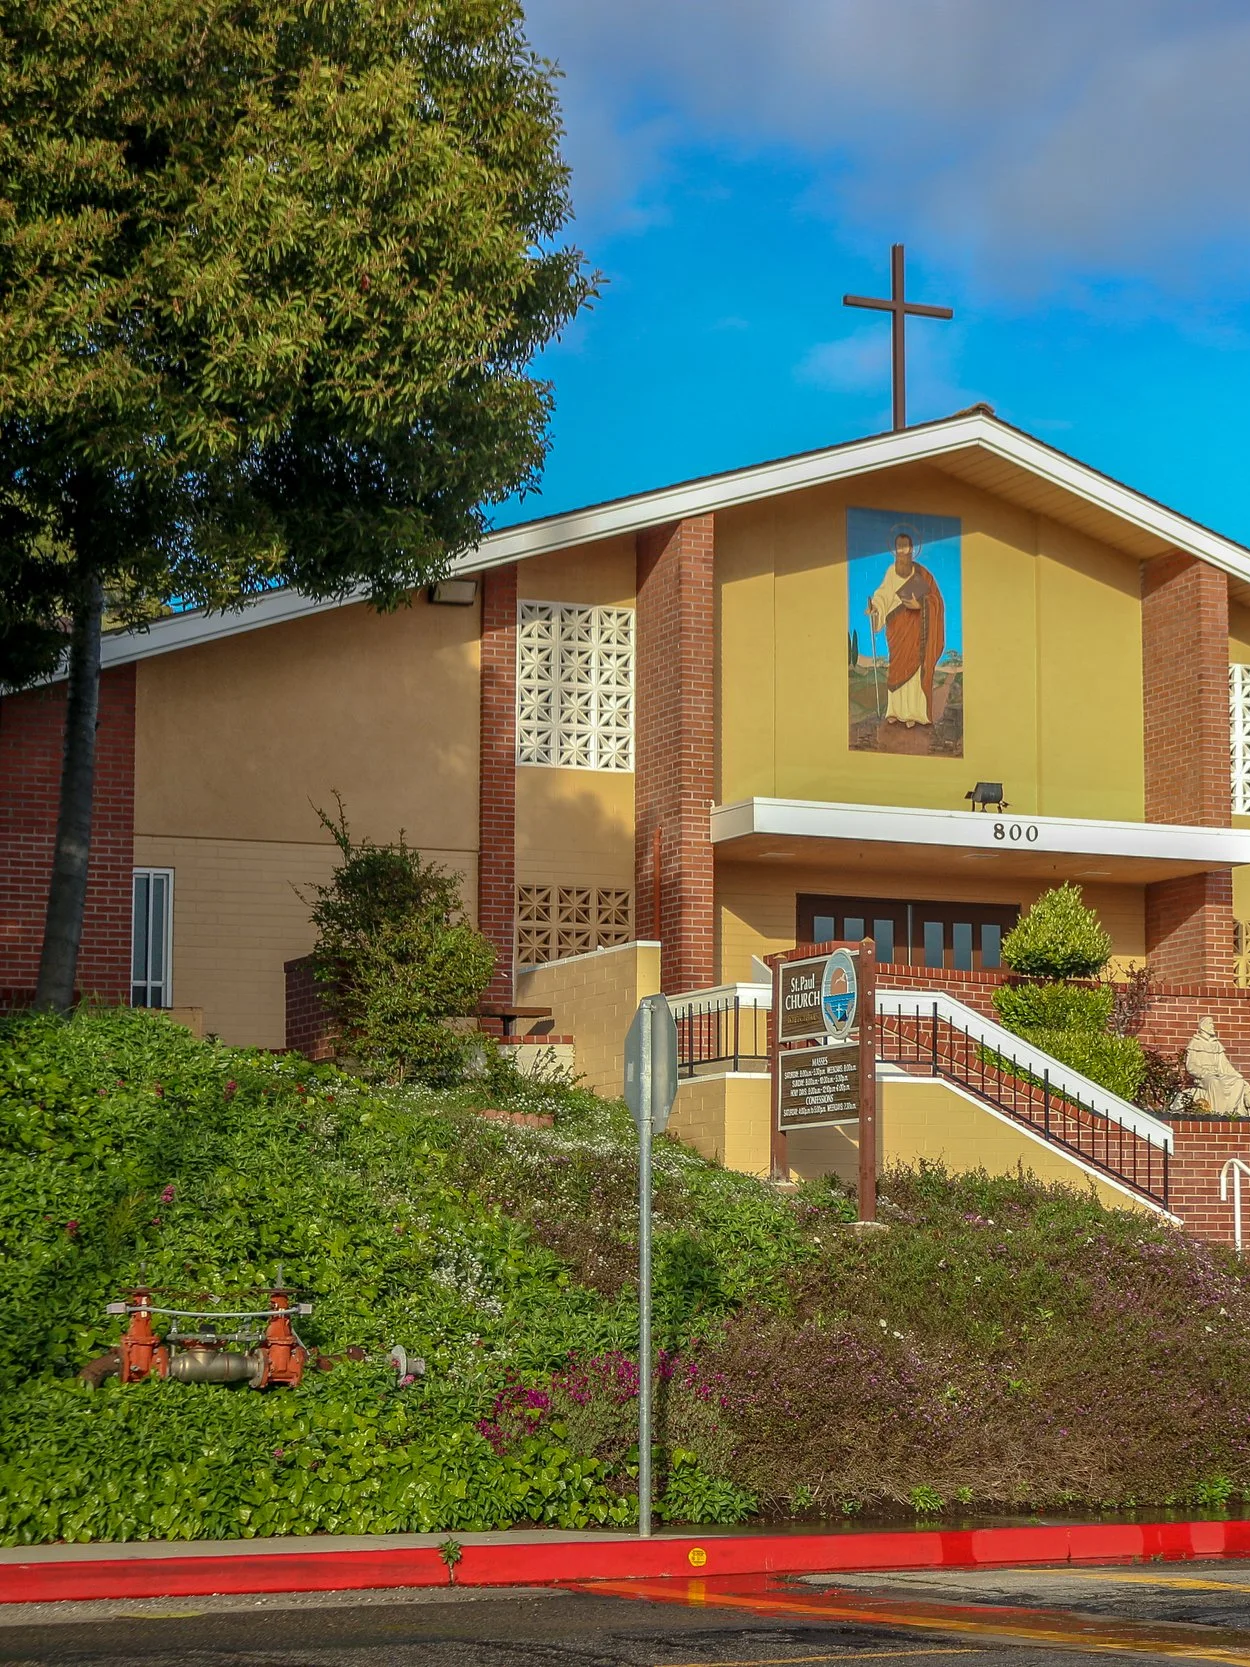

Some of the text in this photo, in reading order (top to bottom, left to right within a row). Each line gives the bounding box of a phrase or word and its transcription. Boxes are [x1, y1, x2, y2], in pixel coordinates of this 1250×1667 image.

[993, 823, 1038, 842] 800
[801, 973, 815, 991] Paul
[785, 991, 820, 1011] CHURCH
